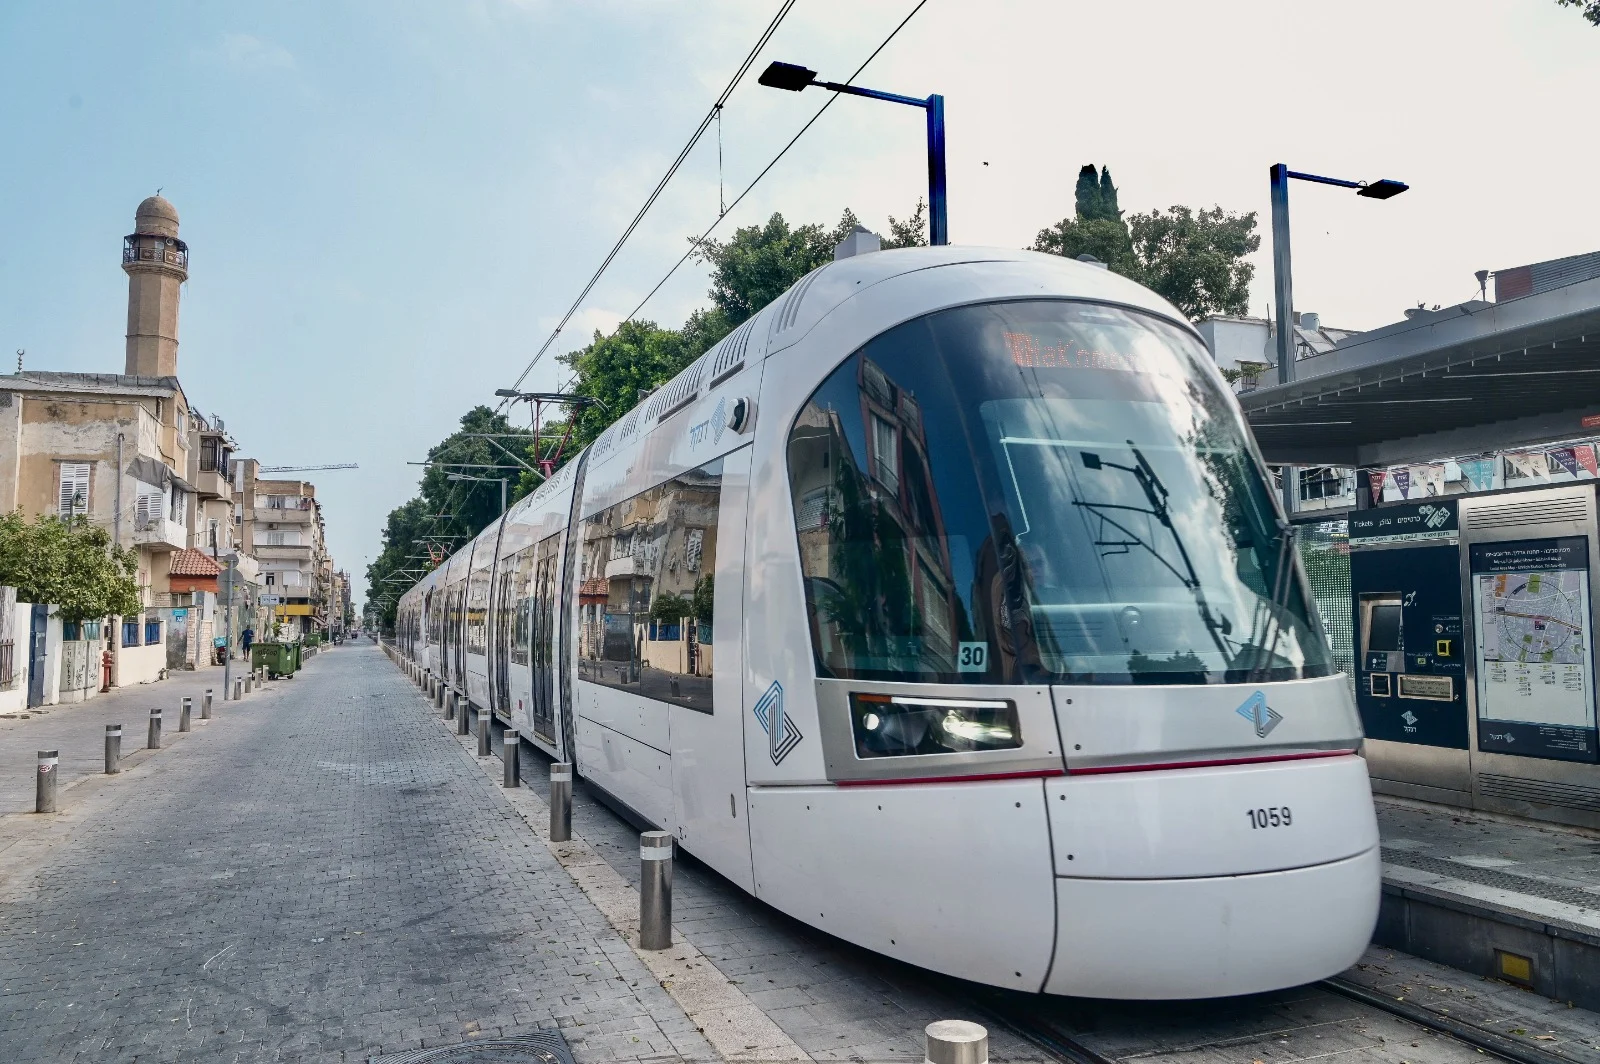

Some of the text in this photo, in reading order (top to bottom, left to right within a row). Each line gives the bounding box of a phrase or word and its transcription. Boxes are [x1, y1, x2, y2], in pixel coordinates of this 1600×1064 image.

[1353, 520, 1374, 528] Tickets
[1397, 515, 1421, 524] כרטיסים
[961, 646, 983, 666] 30
[1489, 733, 1503, 741] דנקל
[1246, 806, 1292, 830] 1059
